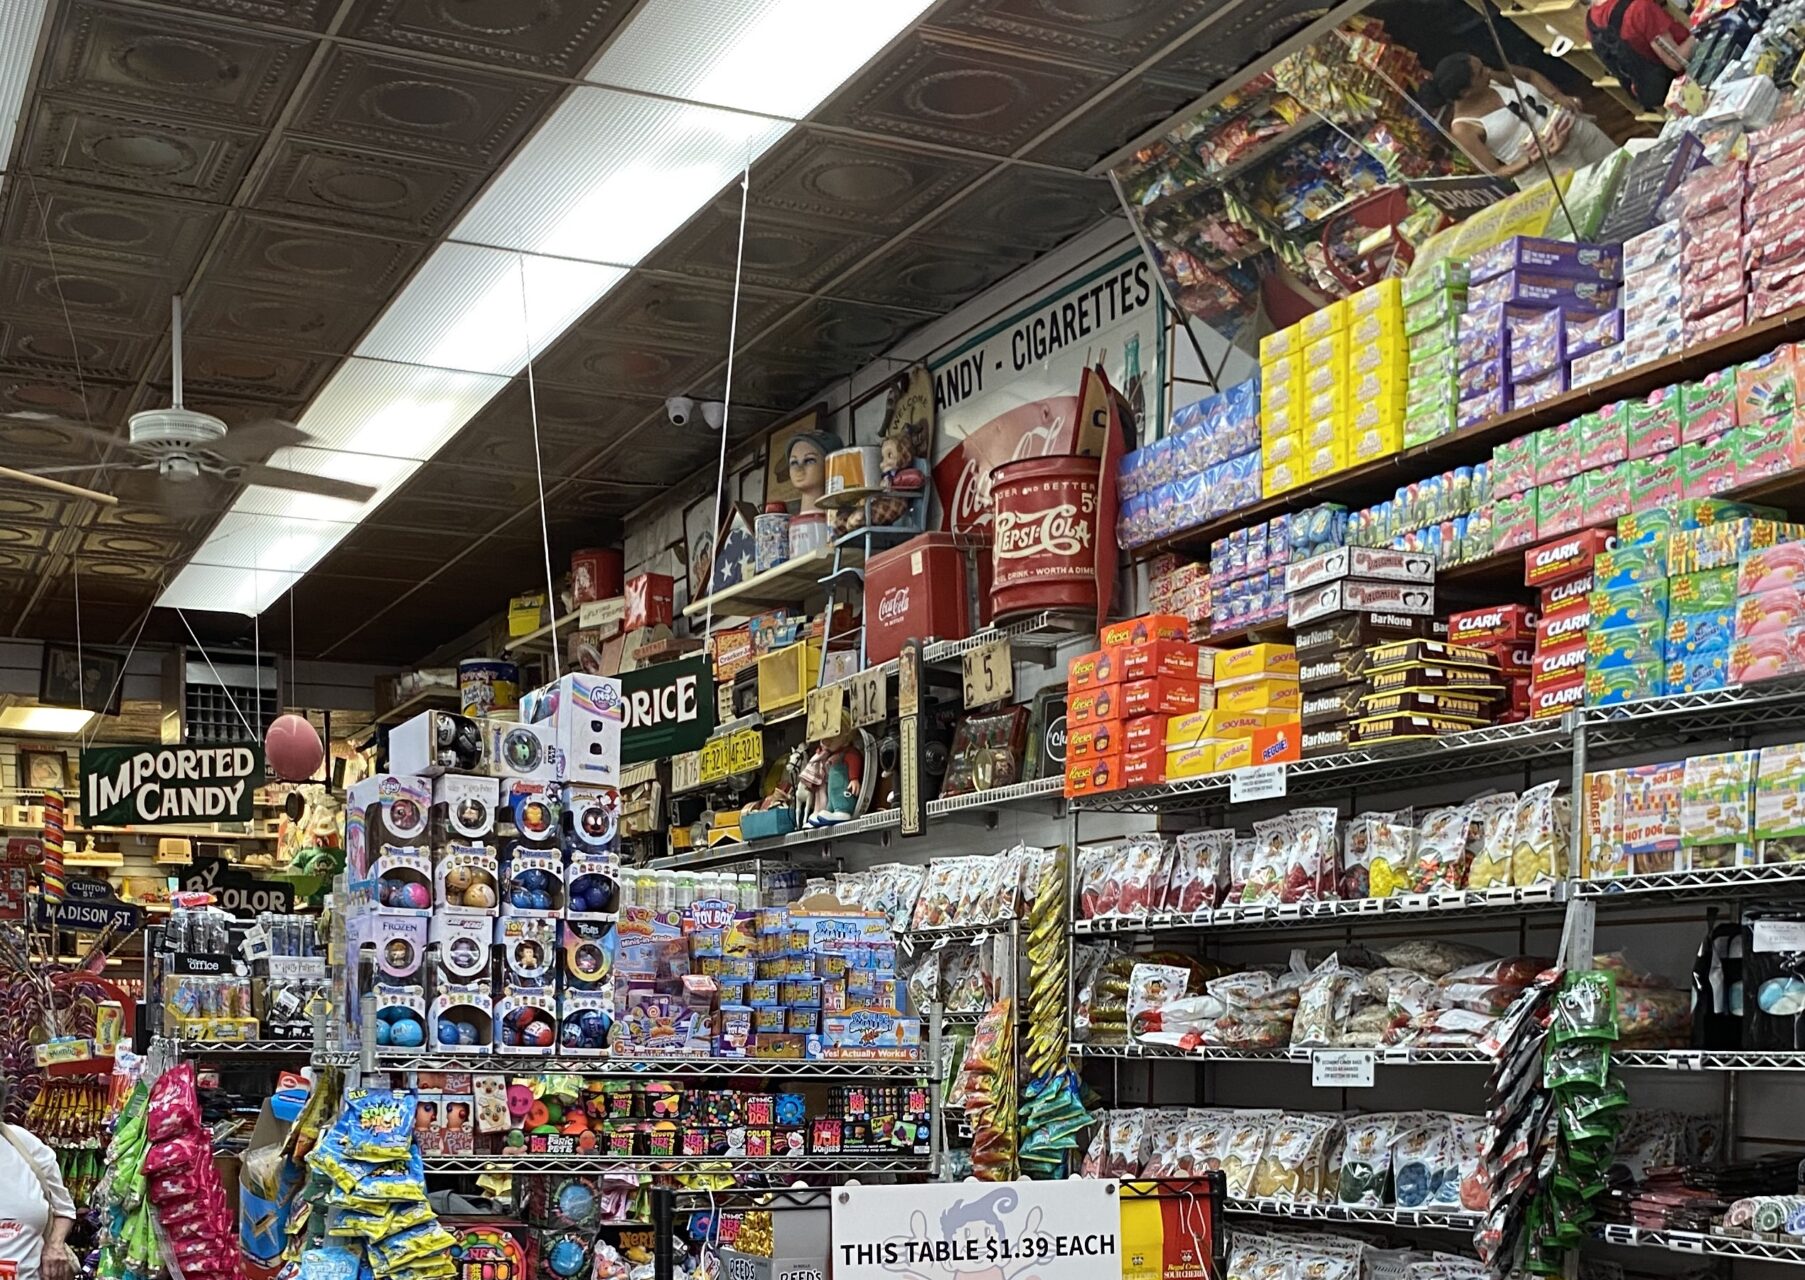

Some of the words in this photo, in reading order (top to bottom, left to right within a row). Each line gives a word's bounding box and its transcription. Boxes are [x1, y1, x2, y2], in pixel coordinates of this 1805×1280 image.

[933, 350, 985, 413] ANDY
[1012, 261, 1150, 372] CIGARETTES
[893, 395, 928, 430] WELCOME
[1043, 481, 1096, 492] BETTER
[1536, 540, 1581, 567] CLARK
[1008, 571, 1029, 581] DRINK
[1036, 566, 1067, 575] WORTH
[1075, 566, 1095, 575] DIME
[1550, 575, 1593, 602] CLARK
[1370, 612, 1413, 627] BarNone
[1458, 609, 1503, 632] CLARK
[1547, 612, 1591, 638] CLARK
[1296, 628, 1334, 647] BarNone
[720, 650, 744, 664] Cracker
[1542, 647, 1587, 673] CLARK
[982, 654, 993, 692] 5
[1300, 662, 1341, 680] BarNone
[621, 675, 697, 729] ORICE
[862, 680, 878, 716] 12
[1303, 695, 1341, 714] BarNone
[1540, 682, 1585, 708] CLARK
[821, 701, 829, 729] 5
[1302, 729, 1343, 747] BarNone
[88, 748, 255, 817] IMPORTED
[136, 779, 245, 821] CANDY
[1590, 784, 1602, 836] BURGER
[1625, 828, 1643, 842] HOT
[1644, 823, 1663, 838] DOG
[186, 861, 220, 893] BY
[71, 882, 107, 895] CLINTON
[45, 905, 109, 923] MADISON
[113, 911, 132, 928] ST.
[504, 920, 525, 932] TOY
[693, 912, 713, 925] TOY
[715, 911, 734, 925] BOX
[382, 921, 418, 932] FROZEN
[188, 960, 219, 971] office
[823, 1049, 840, 1058] Yes!
[841, 1049, 877, 1058] Actually
[877, 1049, 907, 1058] Works!
[348, 1089, 369, 1100] BLUE
[748, 1103, 769, 1114] NEE
[748, 1113, 769, 1125] DOH
[814, 1119, 841, 1133] NEE
[548, 1145, 573, 1153] PETE
[650, 1138, 669, 1147] NEE
[840, 1242, 898, 1266] THIS
[904, 1239, 979, 1263] TABLE
[986, 1235, 1049, 1263] $1.39
[1055, 1234, 1115, 1257] EACH
